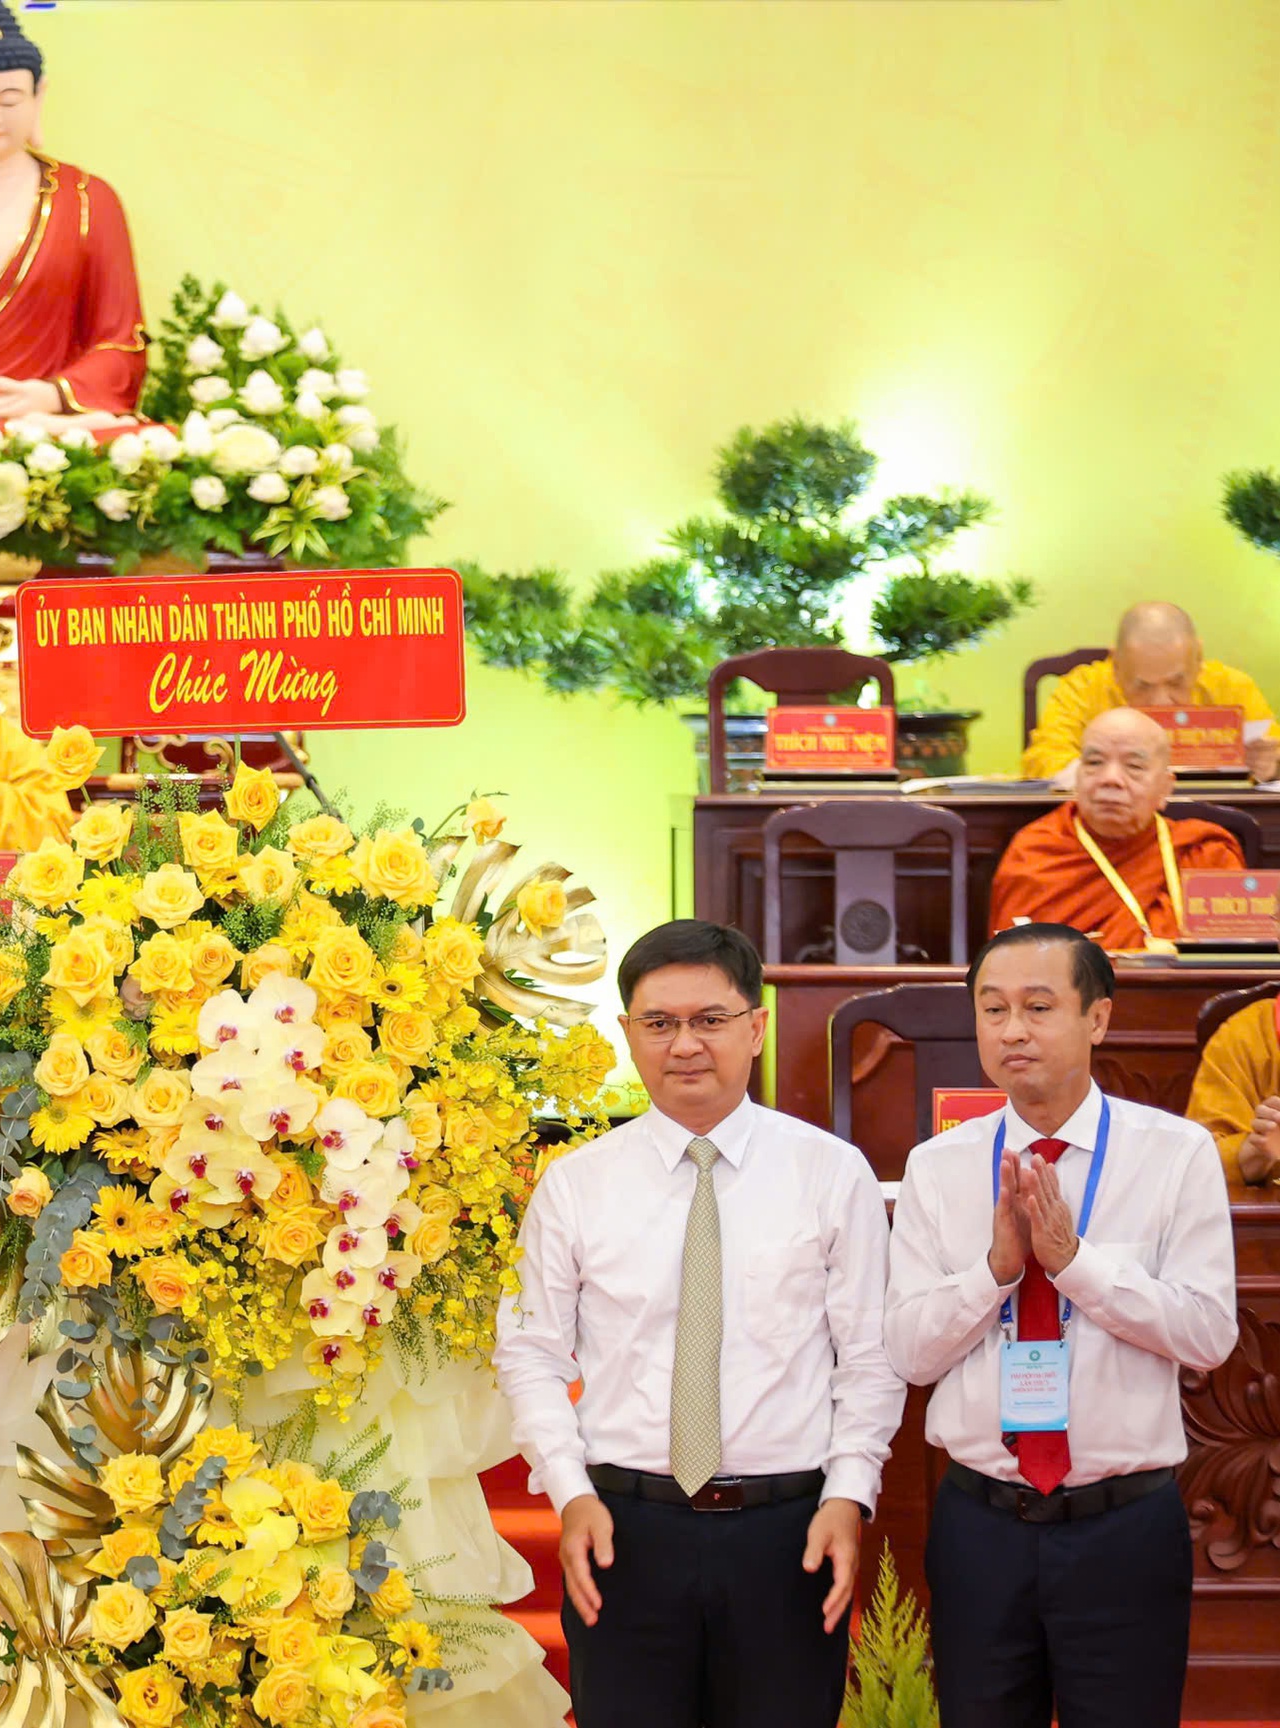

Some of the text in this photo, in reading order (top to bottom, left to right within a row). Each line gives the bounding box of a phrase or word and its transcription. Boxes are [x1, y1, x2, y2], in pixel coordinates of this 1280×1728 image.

[36, 582, 445, 647] ỦY BAN NHÂN DÂN THÀNH PHỐ HỒ CHÍ MINH
[149, 649, 339, 717] Chúc Mừng
